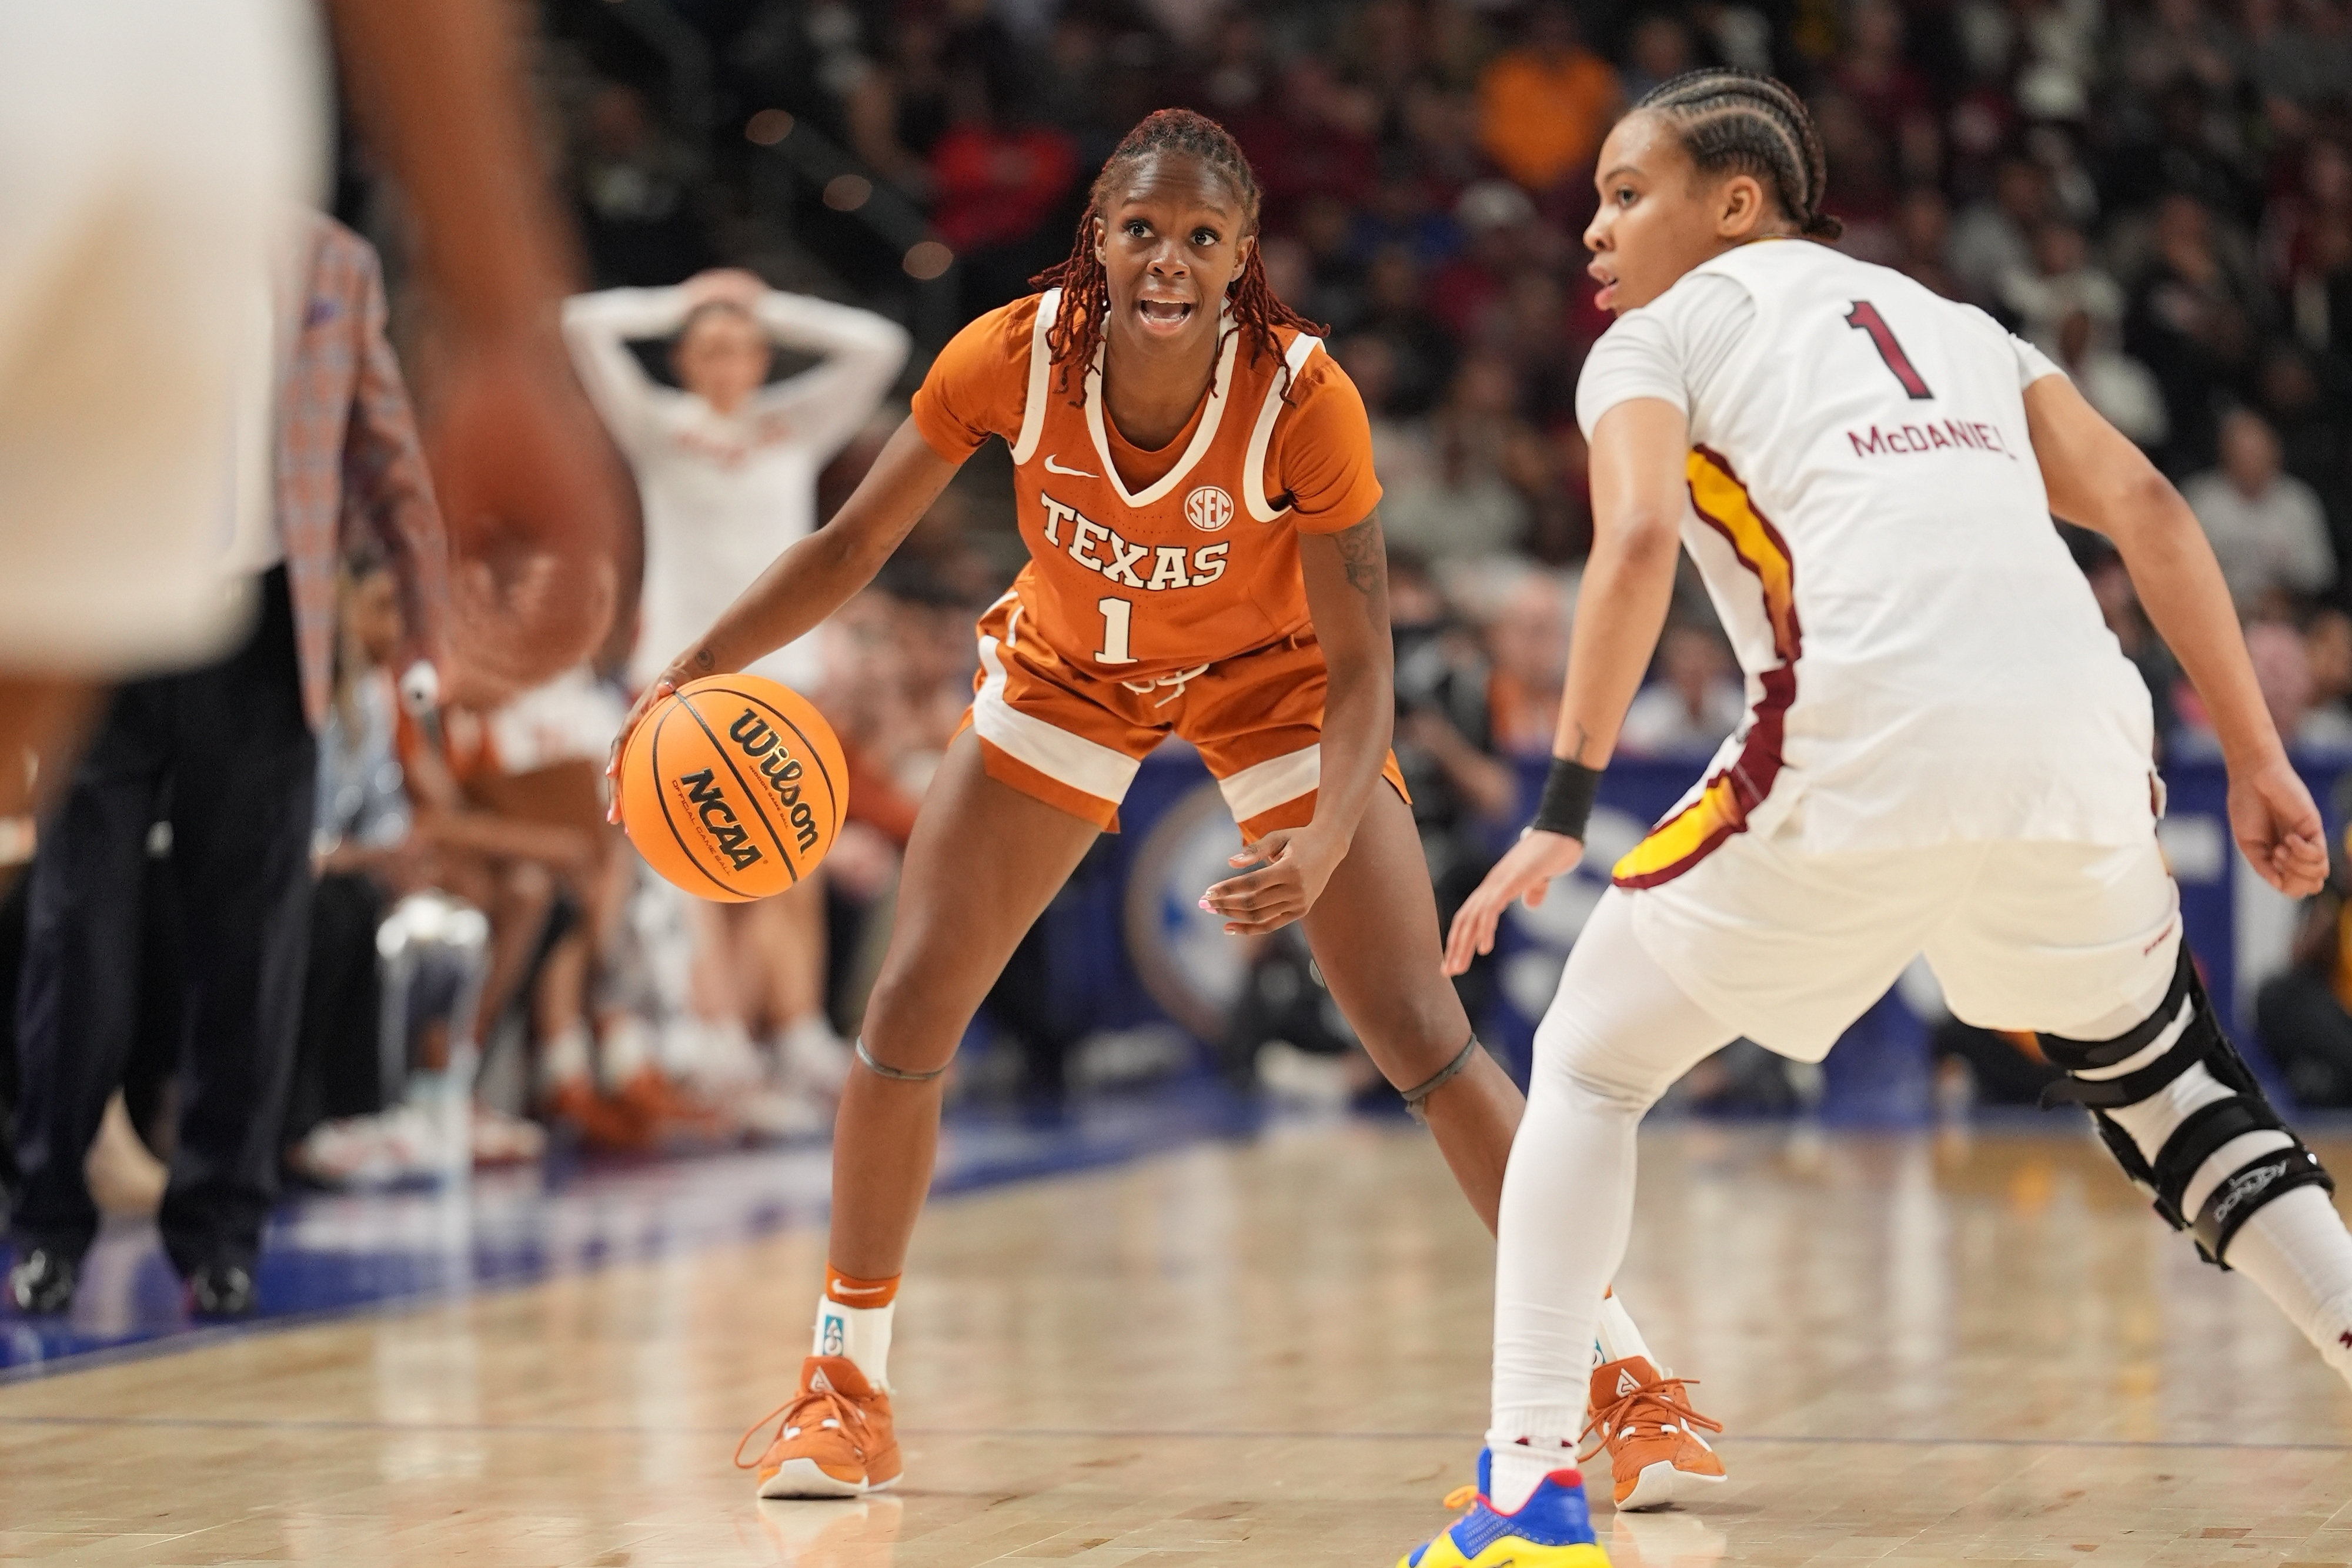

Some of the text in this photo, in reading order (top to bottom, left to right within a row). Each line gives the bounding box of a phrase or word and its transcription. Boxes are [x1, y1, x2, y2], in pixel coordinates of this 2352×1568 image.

[1844, 300, 1935, 399] 1
[1041, 490, 1230, 591] TEXAS
[1190, 488, 1231, 529] SEC
[1094, 597, 1140, 664] 1
[672, 780, 730, 877] OFFICIAL GAME BALL
[681, 768, 764, 872] NCAA
[729, 708, 818, 855] Wilson
[749, 765, 789, 830] INDOOR GAME BALL
